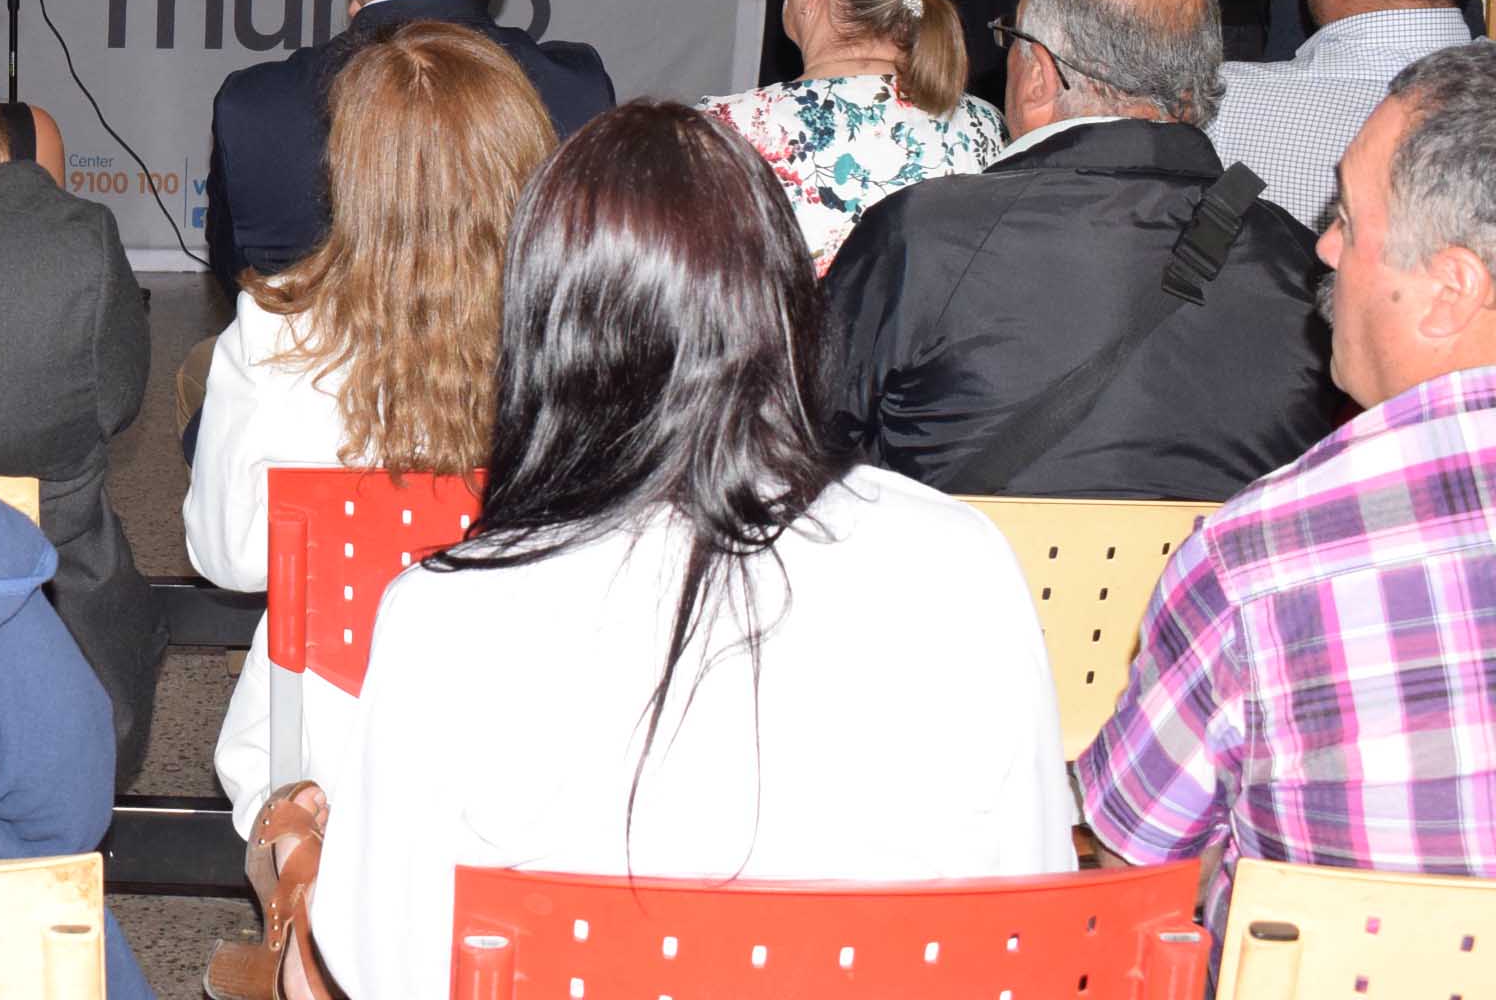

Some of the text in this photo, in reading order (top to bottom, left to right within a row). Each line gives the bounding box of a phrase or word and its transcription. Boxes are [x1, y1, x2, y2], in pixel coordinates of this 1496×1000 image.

[69, 154, 114, 168] Center
[70, 171, 129, 194] 9100
[136, 172, 180, 195] 100
